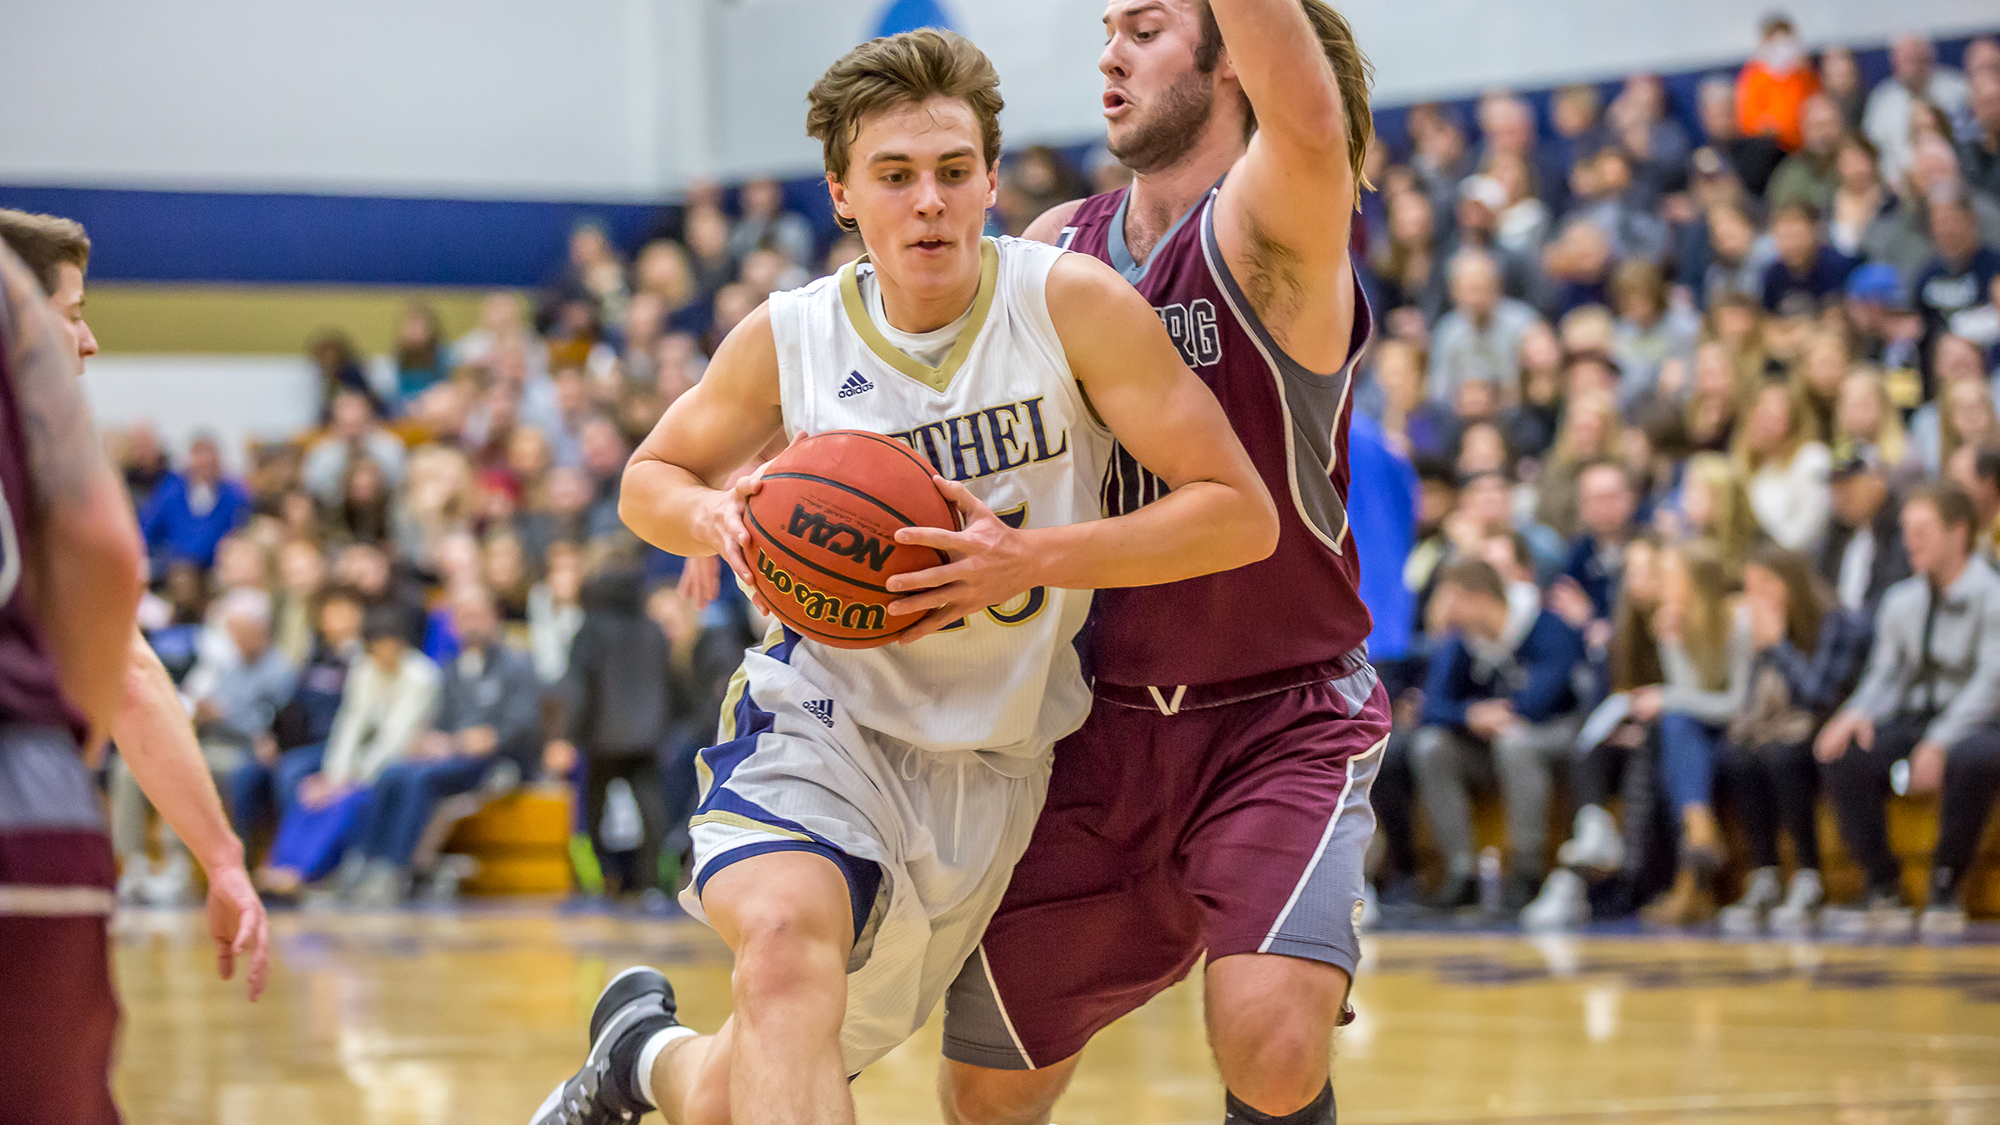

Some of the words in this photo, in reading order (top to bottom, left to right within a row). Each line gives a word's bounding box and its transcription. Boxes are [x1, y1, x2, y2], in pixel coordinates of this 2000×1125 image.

[1152, 298, 1222, 368] RG
[838, 381, 874, 399] adidas
[886, 396, 1067, 483] THEL
[787, 503, 896, 573] NCAA
[757, 547, 887, 631] Wilson
[802, 701, 835, 728] adidas
